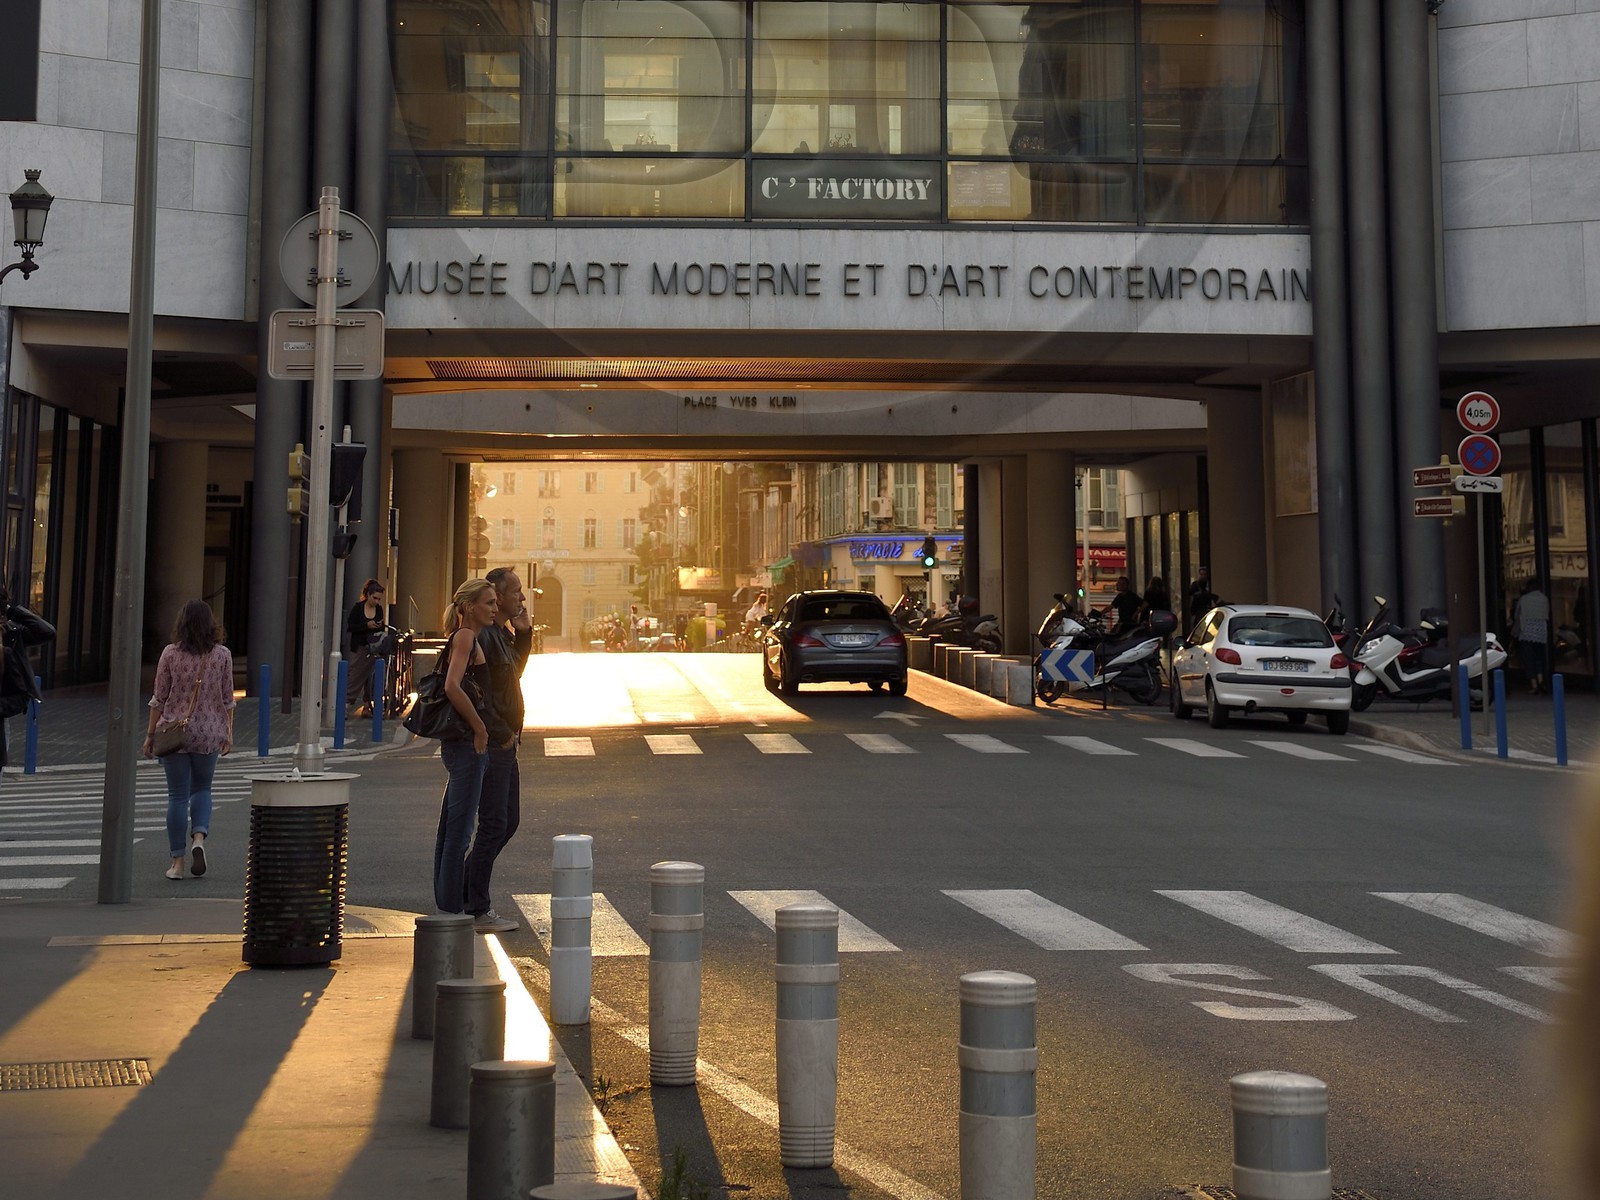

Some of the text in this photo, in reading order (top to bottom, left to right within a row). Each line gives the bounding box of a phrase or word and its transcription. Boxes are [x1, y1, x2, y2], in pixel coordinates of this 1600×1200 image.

[807, 176, 932, 201] FACTORY
[386, 254, 1311, 301] MUSÉE D'ART MODERNE ET D'ART CONTEMPORAIN
[684, 396, 796, 408] PLACE YVES KLEIN
[1088, 549, 1126, 557] TABAC
